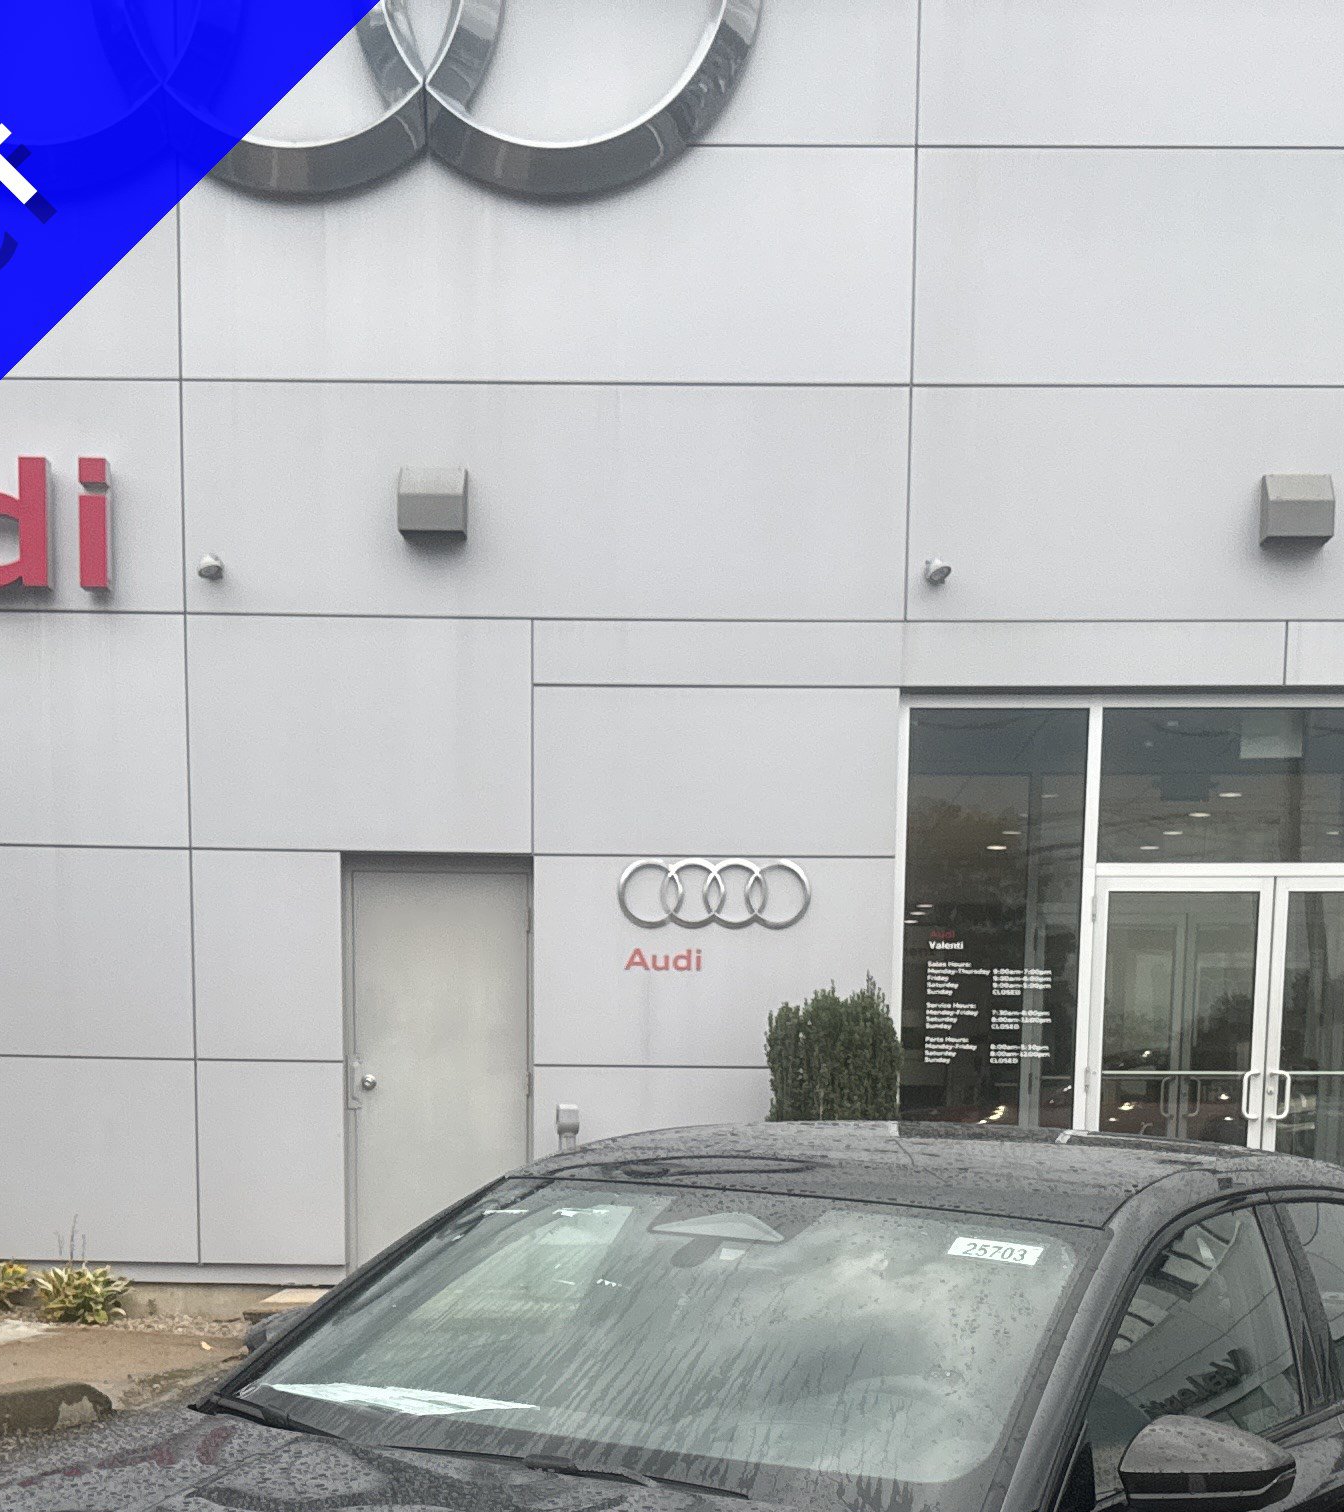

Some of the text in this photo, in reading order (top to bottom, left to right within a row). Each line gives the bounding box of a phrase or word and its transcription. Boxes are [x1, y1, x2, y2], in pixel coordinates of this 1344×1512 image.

[928, 940, 964, 950] Valenti
[623, 947, 703, 972] Audi
[989, 1057, 1019, 1065] CLOSED
[962, 1241, 1028, 1263] 25703
